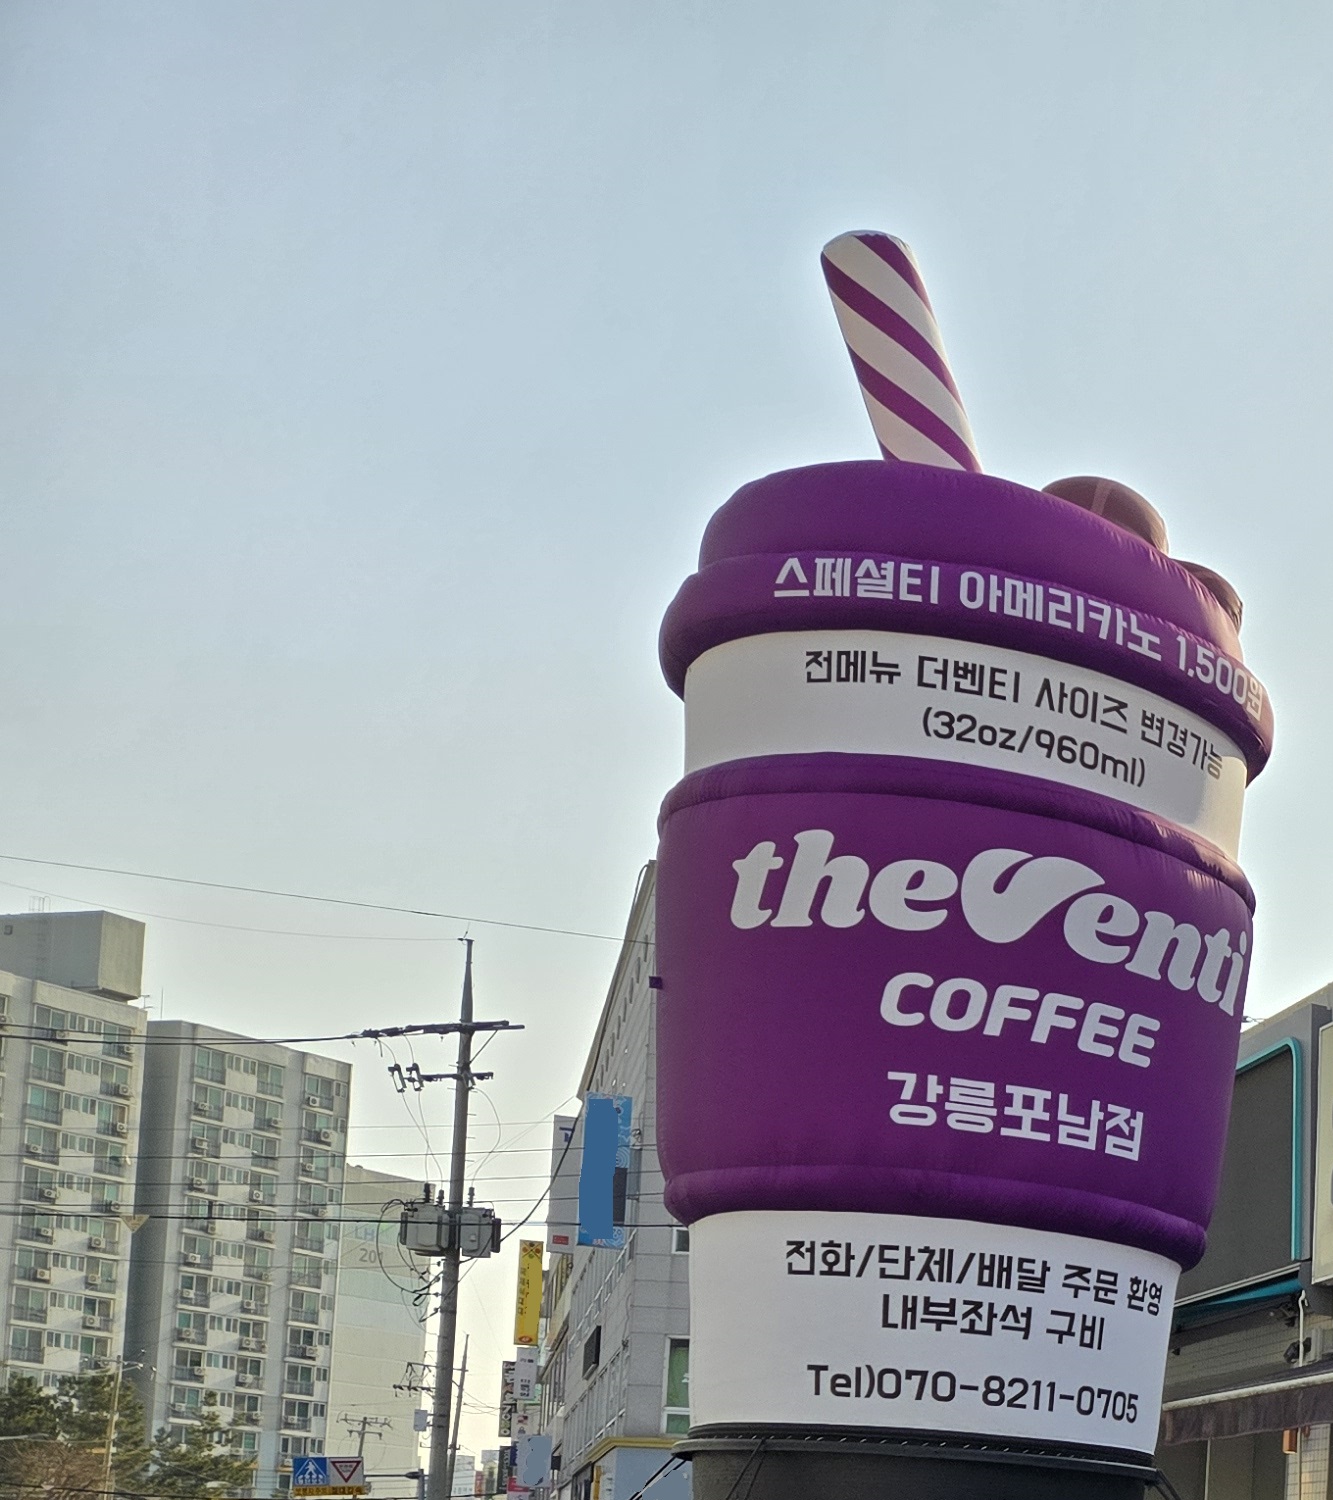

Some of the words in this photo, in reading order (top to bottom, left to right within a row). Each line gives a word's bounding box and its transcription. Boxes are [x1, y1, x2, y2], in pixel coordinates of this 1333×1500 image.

[773, 556, 940, 606] 스페셜티
[958, 568, 1161, 663] 아메리카노
[805, 650, 902, 687] 전메뉴
[916, 655, 1021, 704] 더벤티
[1035, 683, 1129, 729] 사이즈
[1140, 707, 1224, 779] 변경가능
[921, 706, 1147, 788] (32oz/960ml)
[729, 828, 1249, 1016] theVenti
[879, 972, 1162, 1069] COFFEE
[886, 1070, 1145, 1162] 강릉포남점
[785, 1240, 1051, 1296] 전화/단체/배달
[1061, 1263, 1119, 1307] 주문
[1127, 1275, 1163, 1317] 환영
[881, 1293, 1032, 1341] 내부좌석
[1045, 1308, 1104, 1353] 구비
[807, 1363, 1140, 1426] Tel)070-8211-0705
